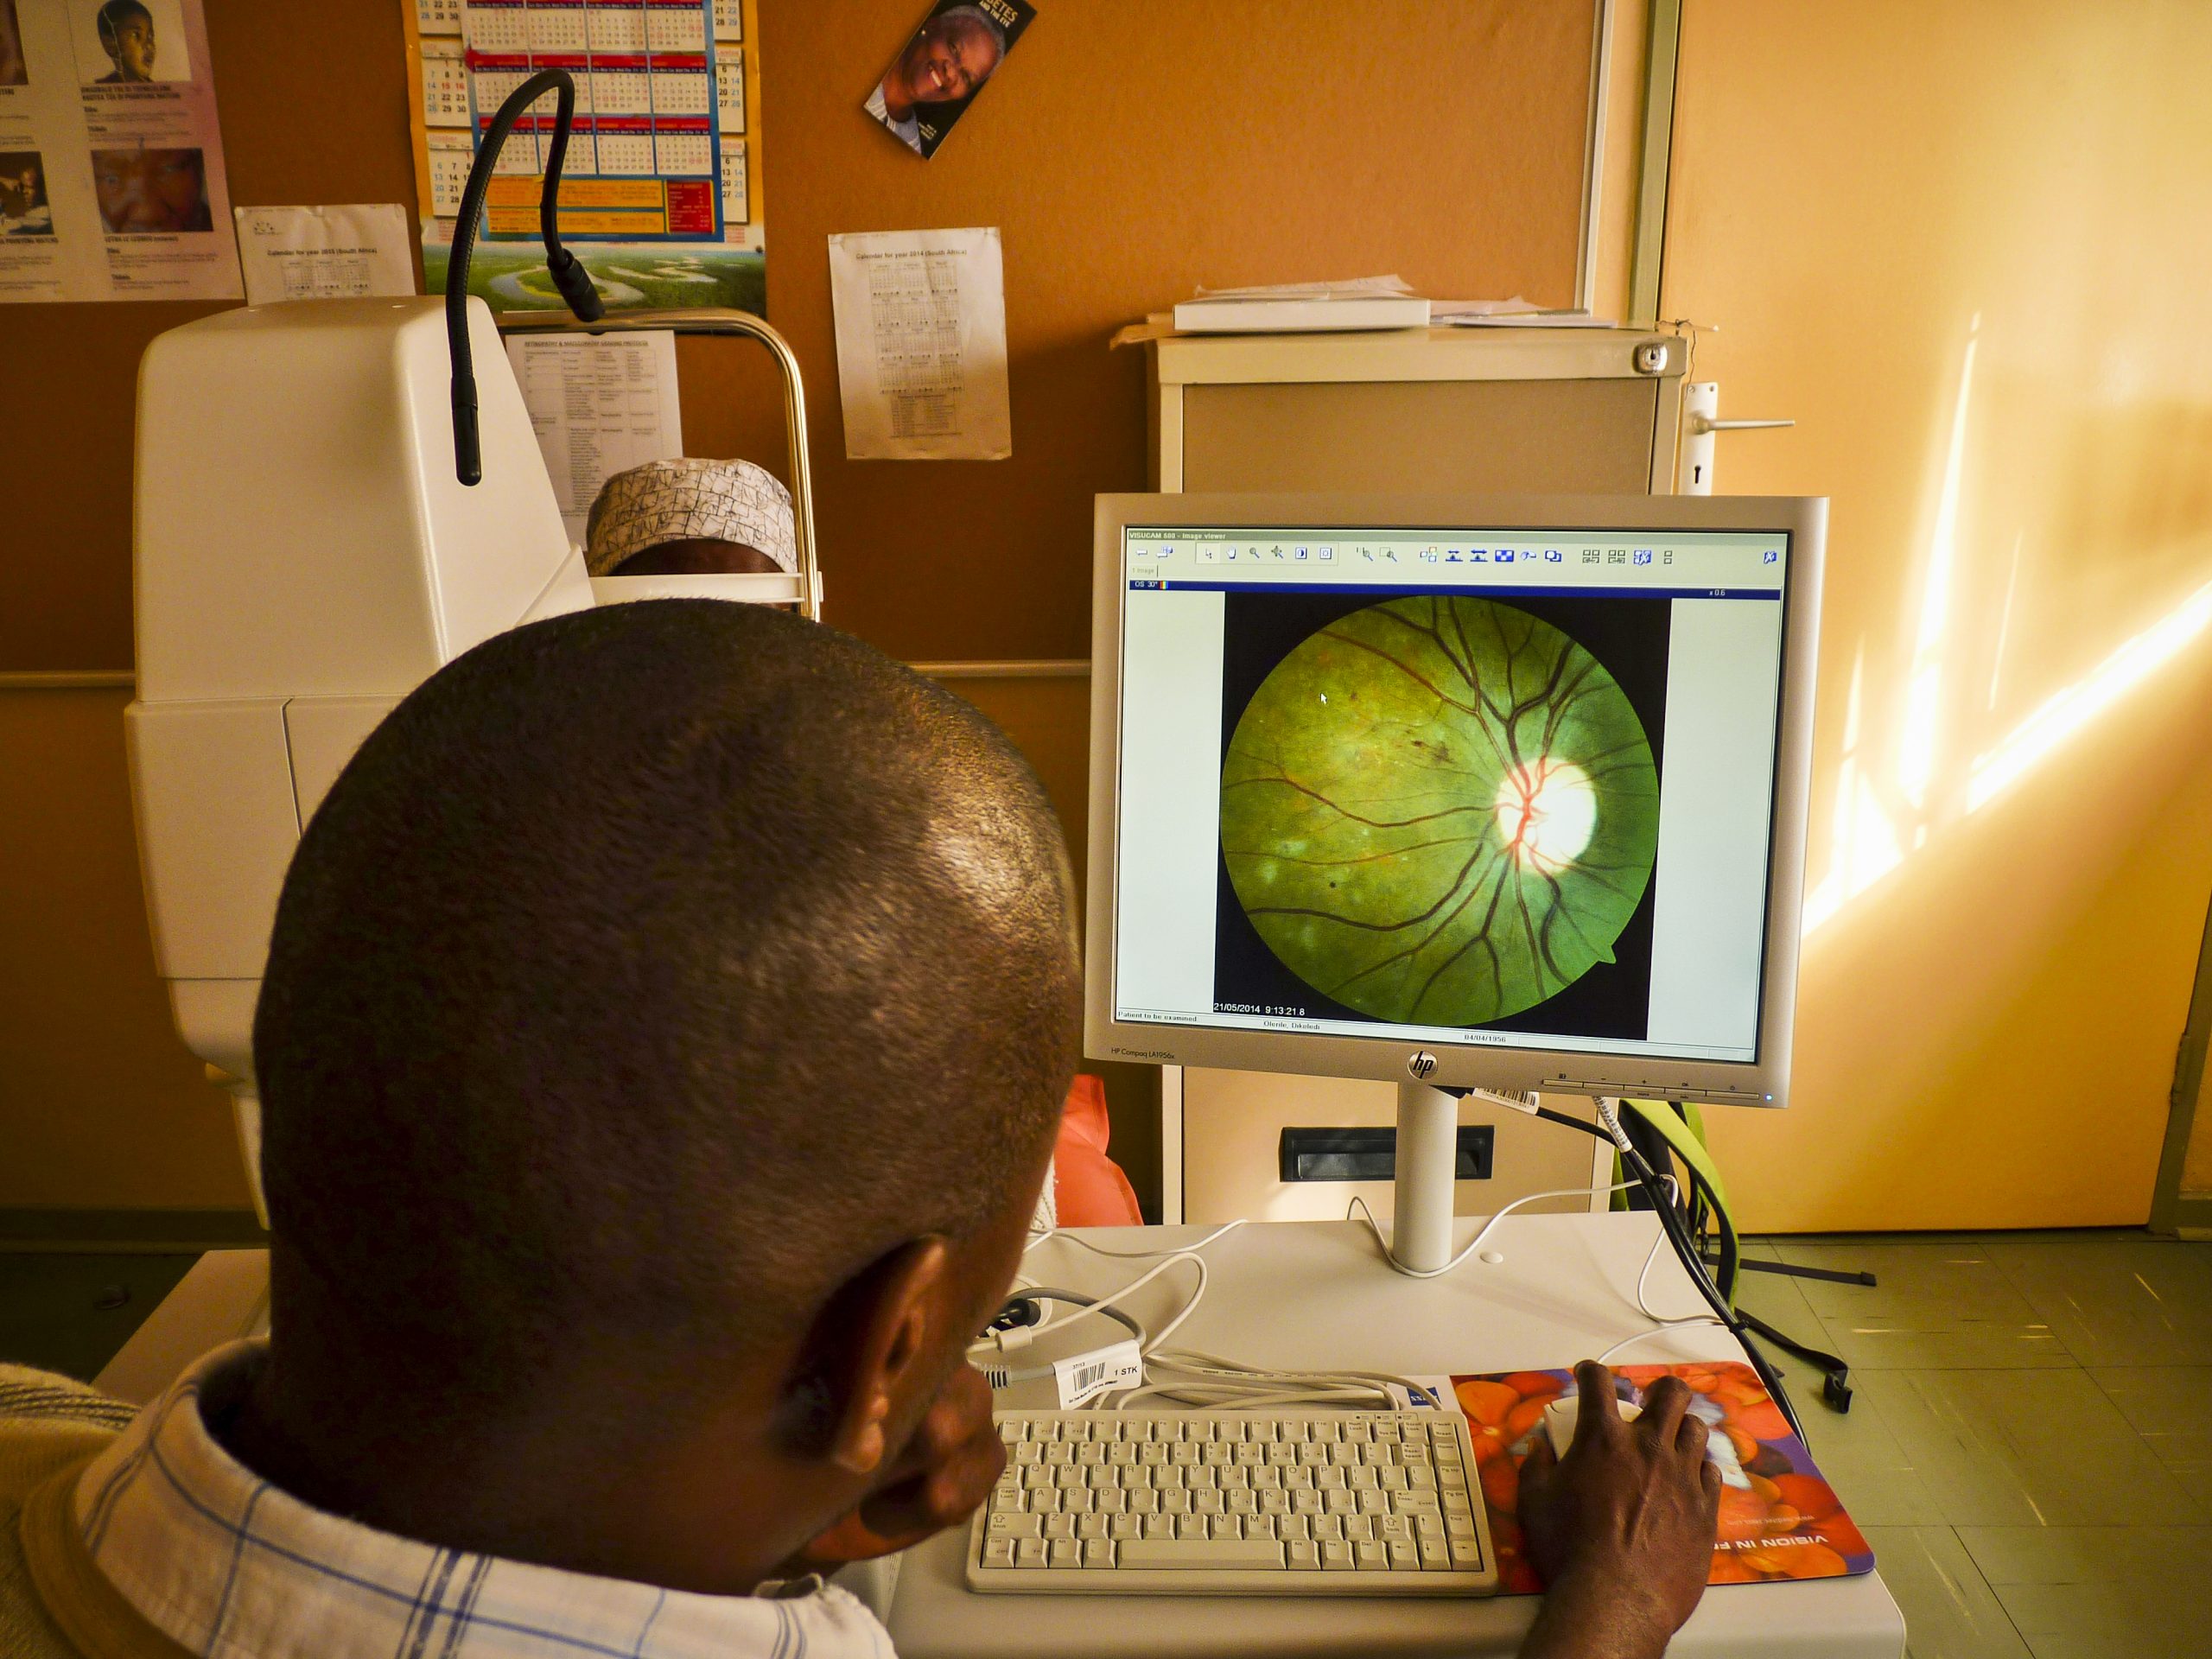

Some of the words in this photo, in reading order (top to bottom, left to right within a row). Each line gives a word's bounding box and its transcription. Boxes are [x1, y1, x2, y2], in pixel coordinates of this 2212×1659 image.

[1213, 1002, 1260, 1014] 21/05/2014
[1265, 1005, 1306, 1016] 9:13:21.8
[1464, 1033, 1507, 1043] 04/04/1956
[1121, 1048, 1147, 1058] Compaq
[1148, 1051, 1175, 1059] LA1956x
[1412, 1050, 1434, 1079] hp
[1121, 1366, 1138, 1376] STK
[1713, 1541, 1731, 1550] F
[1736, 1539, 1757, 1549] IN
[1761, 1535, 1829, 1548] VISION
